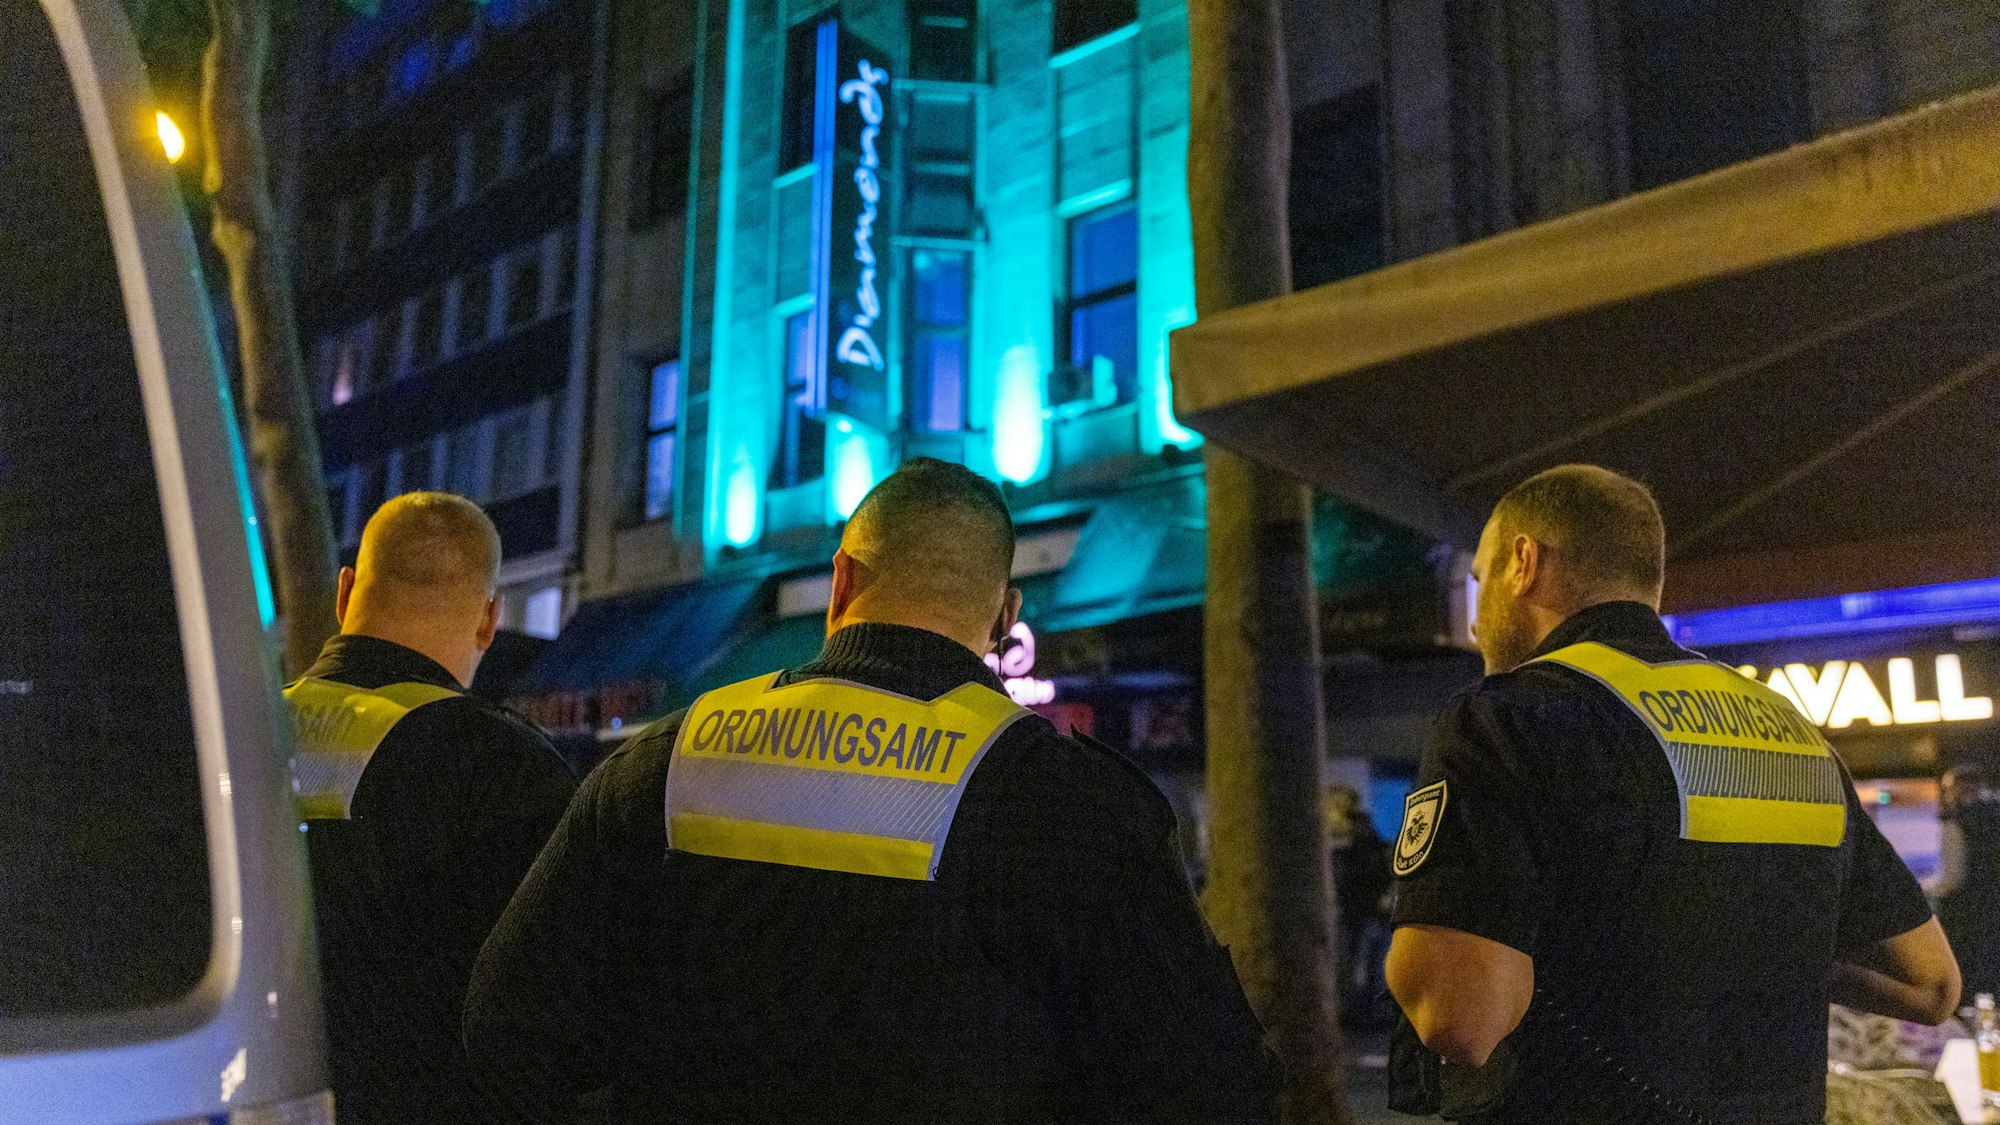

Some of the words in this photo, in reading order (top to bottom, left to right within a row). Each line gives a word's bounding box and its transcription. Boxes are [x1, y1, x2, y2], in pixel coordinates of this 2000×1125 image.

[837, 59, 889, 371] Diamonds
[692, 707, 967, 774] ORDNUNGSAMT
[1638, 689, 1820, 747] ORDNUNGSAMT
